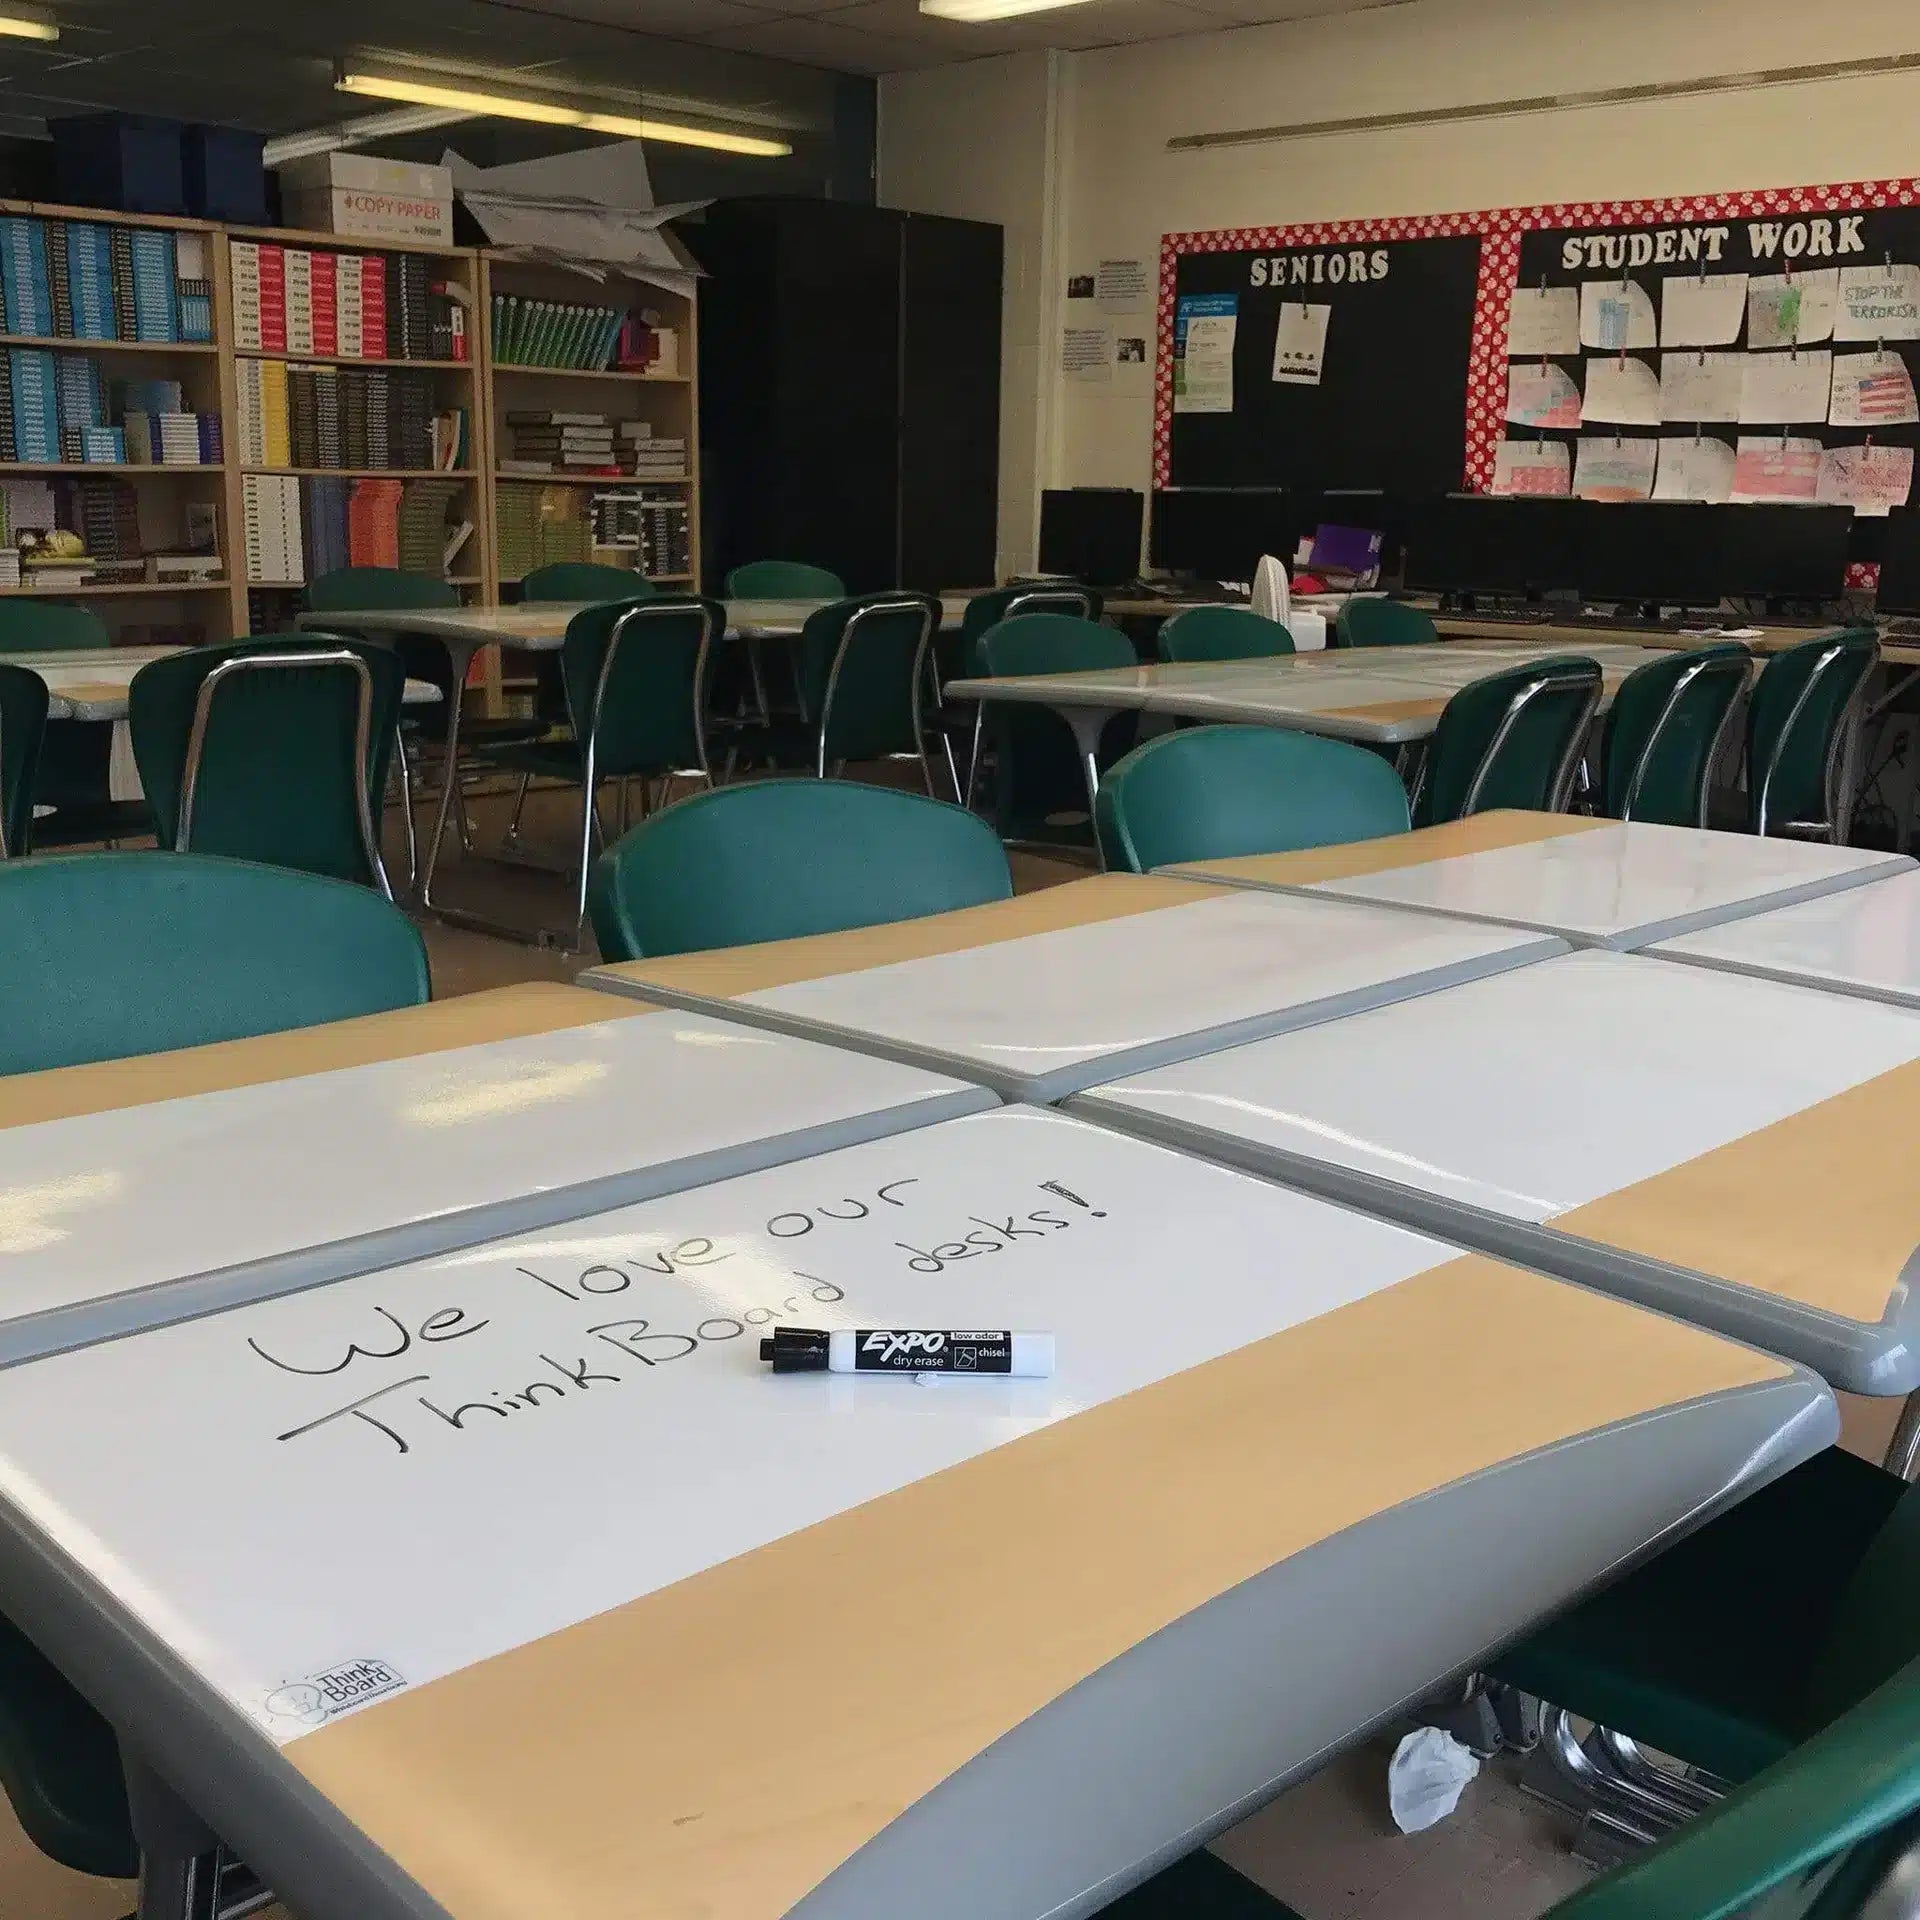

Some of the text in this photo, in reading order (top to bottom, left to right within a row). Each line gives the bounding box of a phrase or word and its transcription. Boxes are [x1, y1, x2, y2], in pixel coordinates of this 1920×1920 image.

[355, 196, 440, 220] COPY PAPER
[1562, 216, 1865, 270] STUDENT WORK
[1250, 250, 1389, 287] SENIORS
[1845, 284, 1904, 300] STOP THE
[1848, 303, 1919, 319] TERRORISM
[895, 1179, 1107, 1272] desks!
[248, 1178, 918, 1374] We love our
[862, 1331, 945, 1362] EXPO
[954, 1332, 999, 1340] low odor
[893, 1355, 944, 1368] dry erase
[978, 1347, 1005, 1357] chisel
[316, 1663, 376, 1688] Think
[323, 1667, 392, 1702] Board
